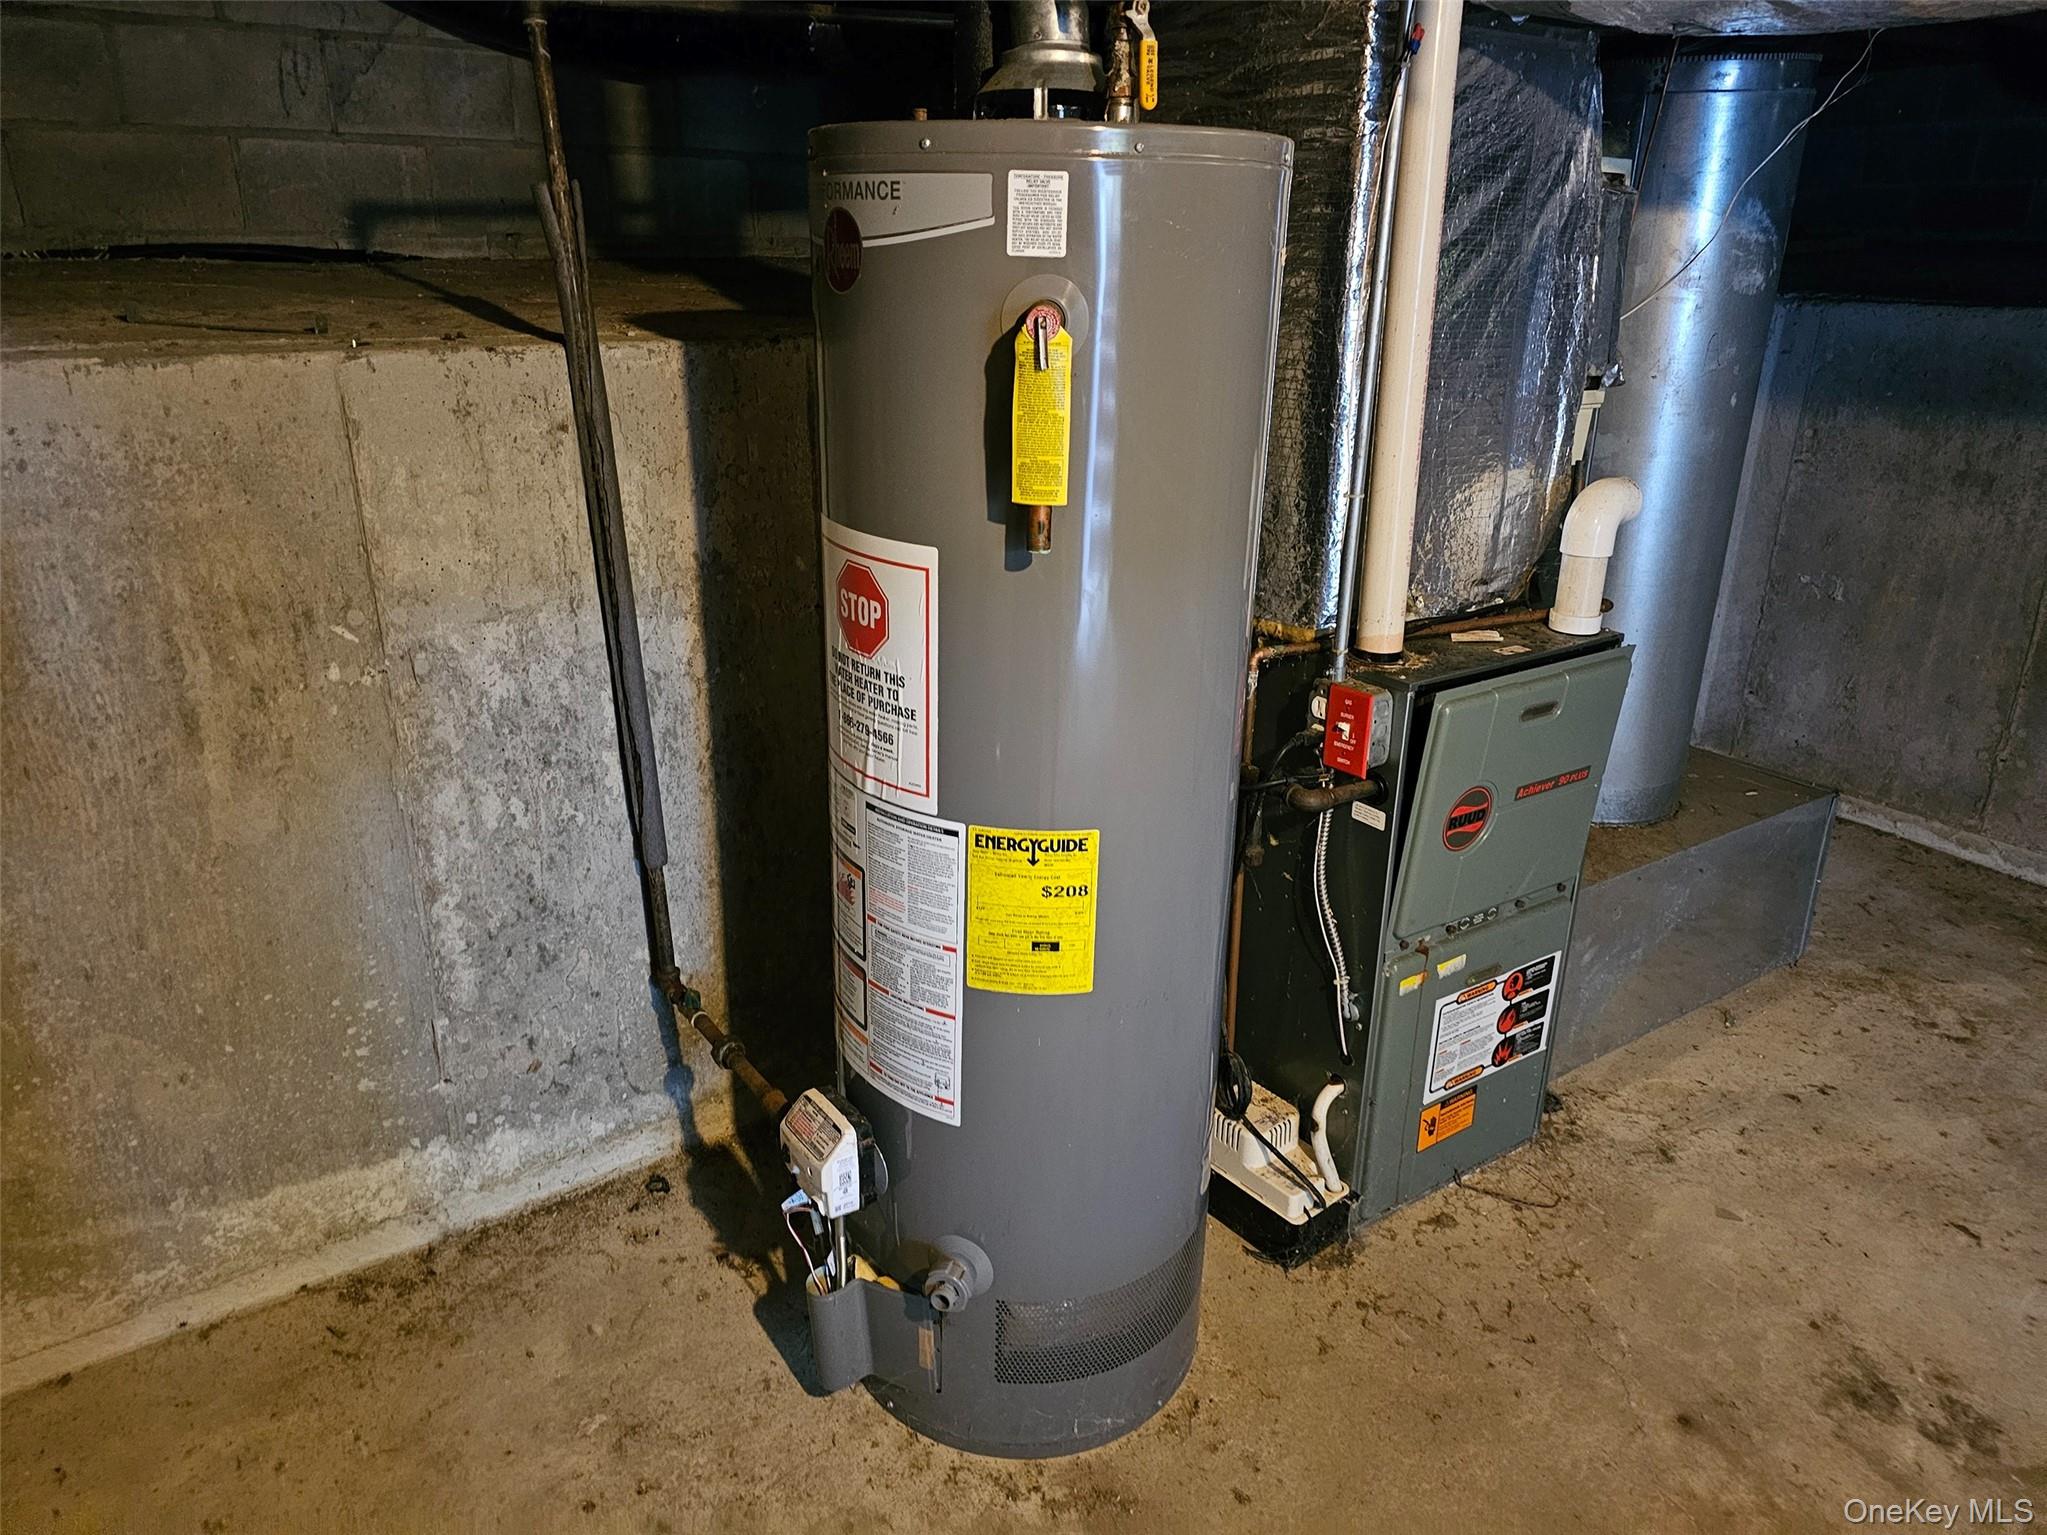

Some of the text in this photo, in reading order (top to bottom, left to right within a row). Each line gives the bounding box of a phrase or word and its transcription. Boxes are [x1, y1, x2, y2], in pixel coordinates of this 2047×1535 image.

[825, 180, 901, 200] ORMANCE
[840, 587, 882, 629] STOP
[851, 658, 881, 682] RETURN
[883, 670, 906, 689] THIS
[854, 674, 885, 698] HEATER
[886, 687, 899, 702] TO
[856, 690, 866, 705] OF
[867, 694, 917, 722] PURCHASE
[1516, 769, 1588, 800] Achiever 90 PLUS
[1449, 808, 1486, 830] RUUD
[974, 833, 1089, 854] ENERGYGUIDE
[1041, 884, 1089, 899] $208
